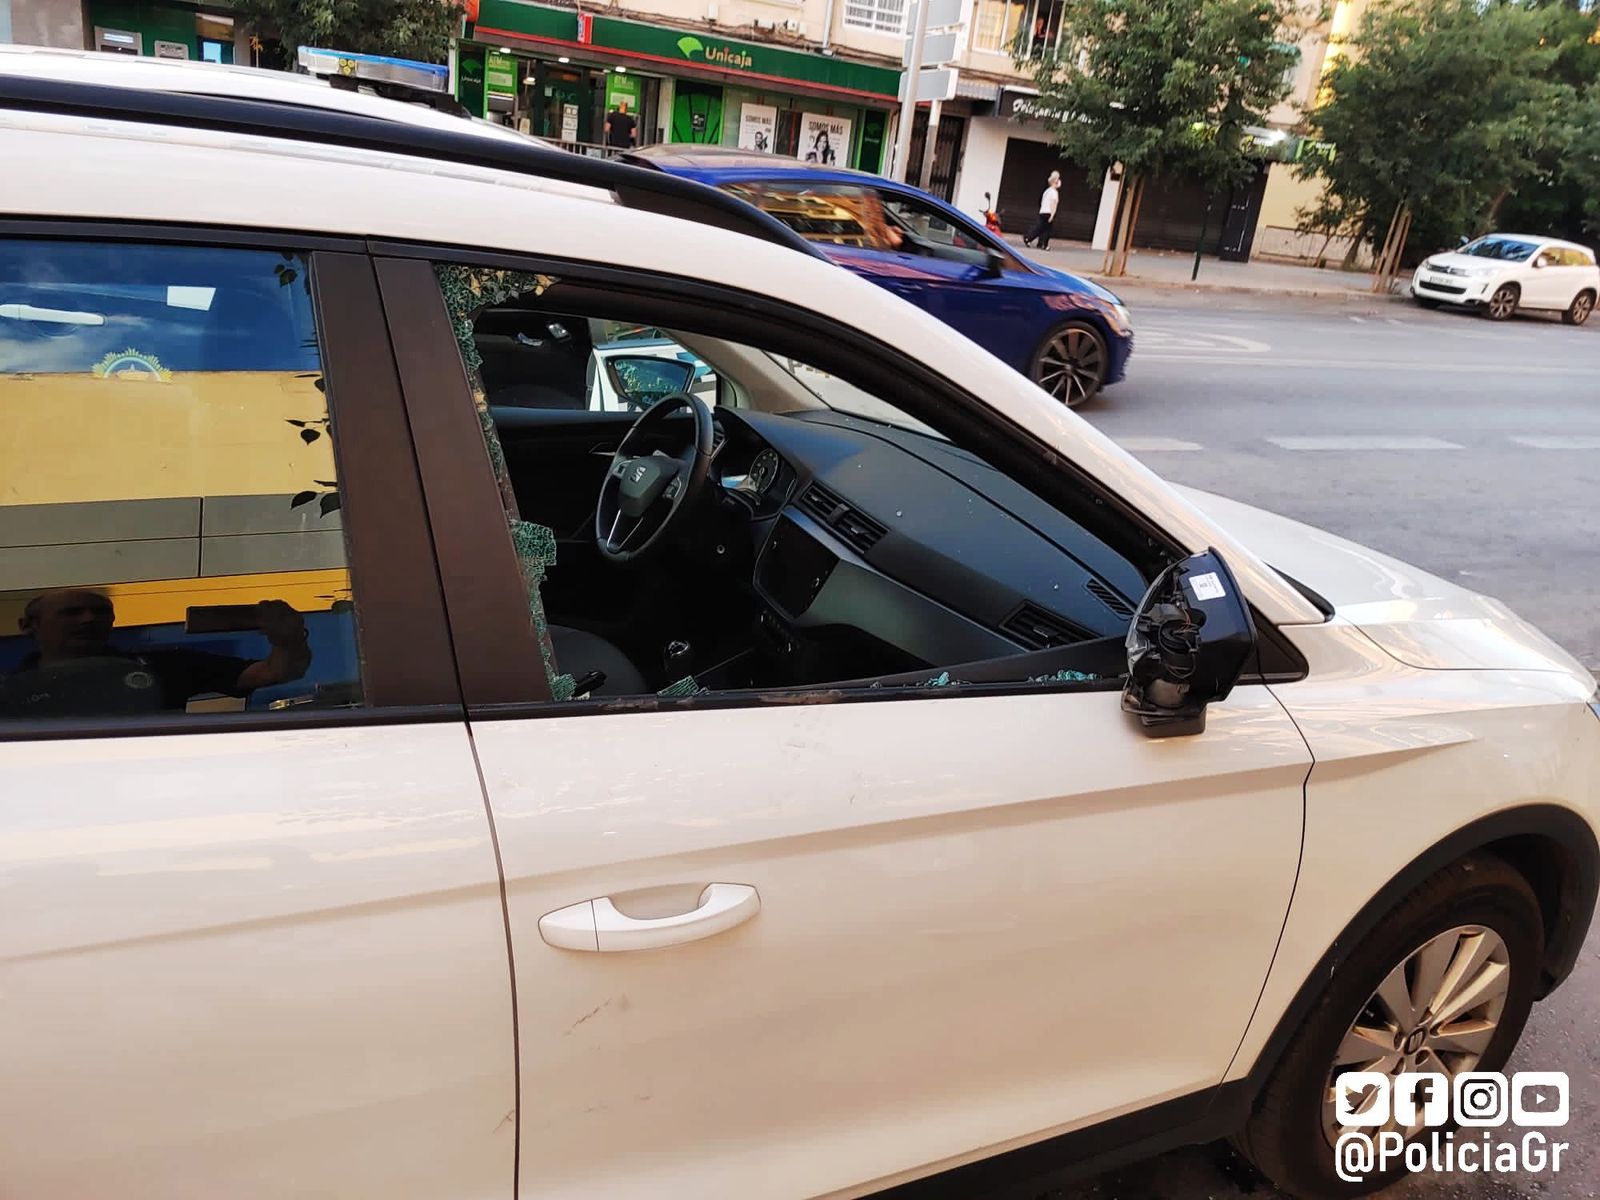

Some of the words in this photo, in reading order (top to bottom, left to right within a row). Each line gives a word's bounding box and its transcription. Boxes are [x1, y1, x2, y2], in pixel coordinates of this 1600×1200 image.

[705, 46, 752, 68] Unicaja
[745, 115, 761, 124] SOMOS
[808, 121, 830, 132] SOMOS
